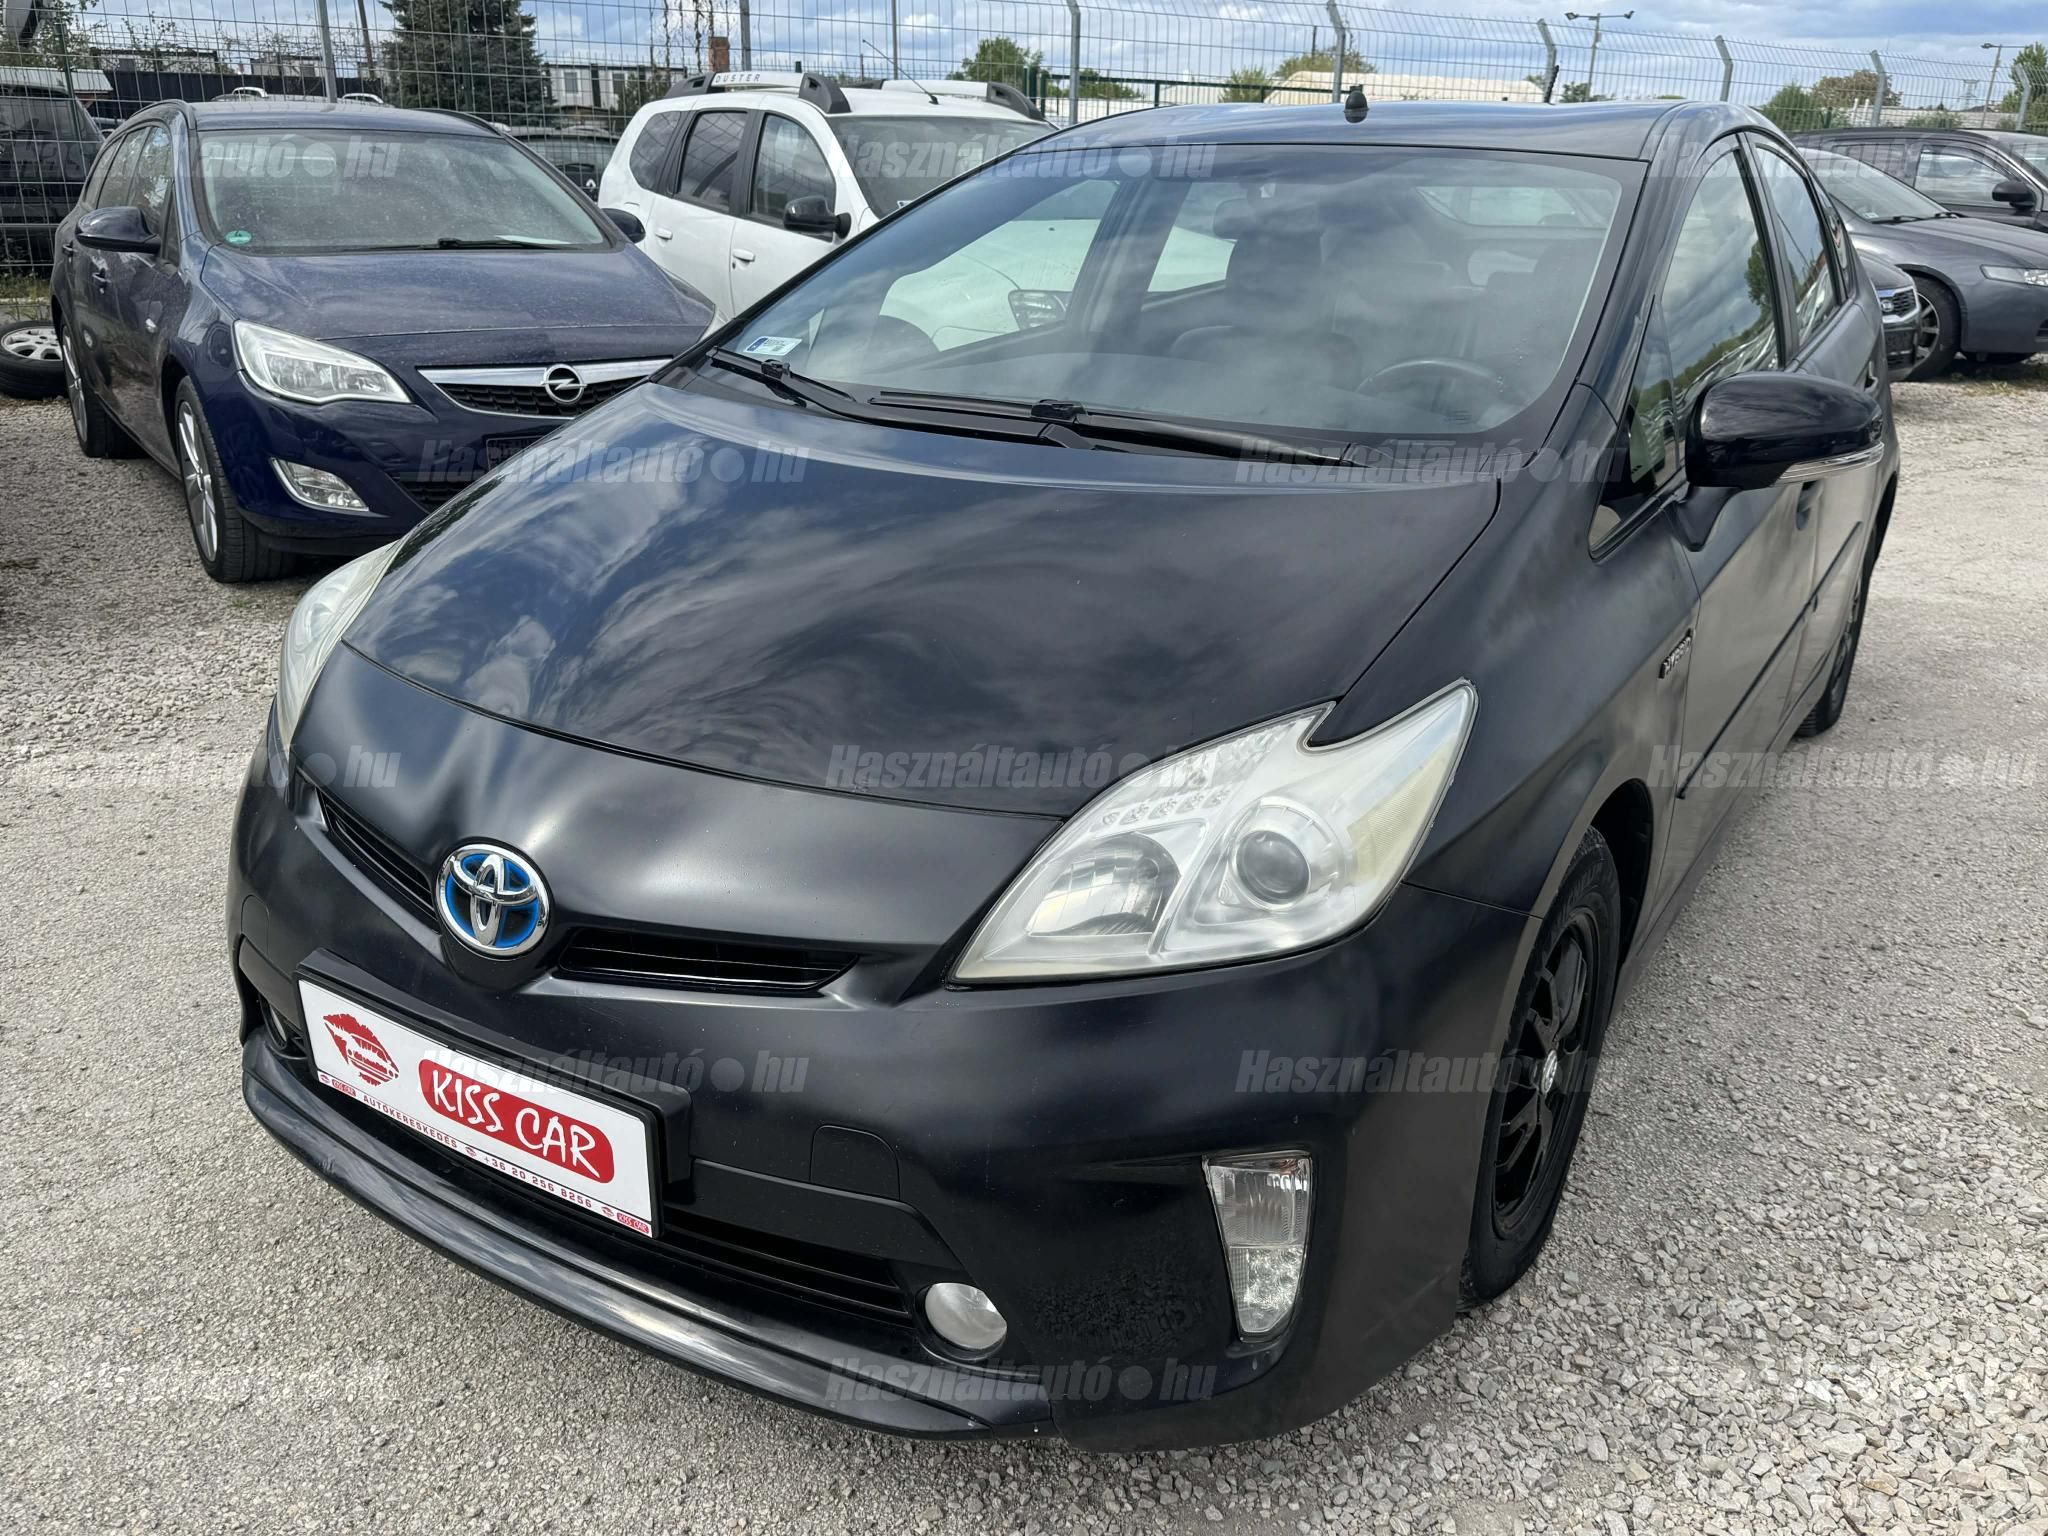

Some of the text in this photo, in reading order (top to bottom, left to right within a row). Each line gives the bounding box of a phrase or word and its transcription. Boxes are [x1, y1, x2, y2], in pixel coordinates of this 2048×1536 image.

[715, 73, 761, 83] DUSTER
[432, 1069, 601, 1178] KISS CAR
[484, 1156, 506, 1171] +36
[511, 1167, 526, 1180] 20
[532, 1176, 554, 1192] 256
[561, 1188, 592, 1208] 8256
